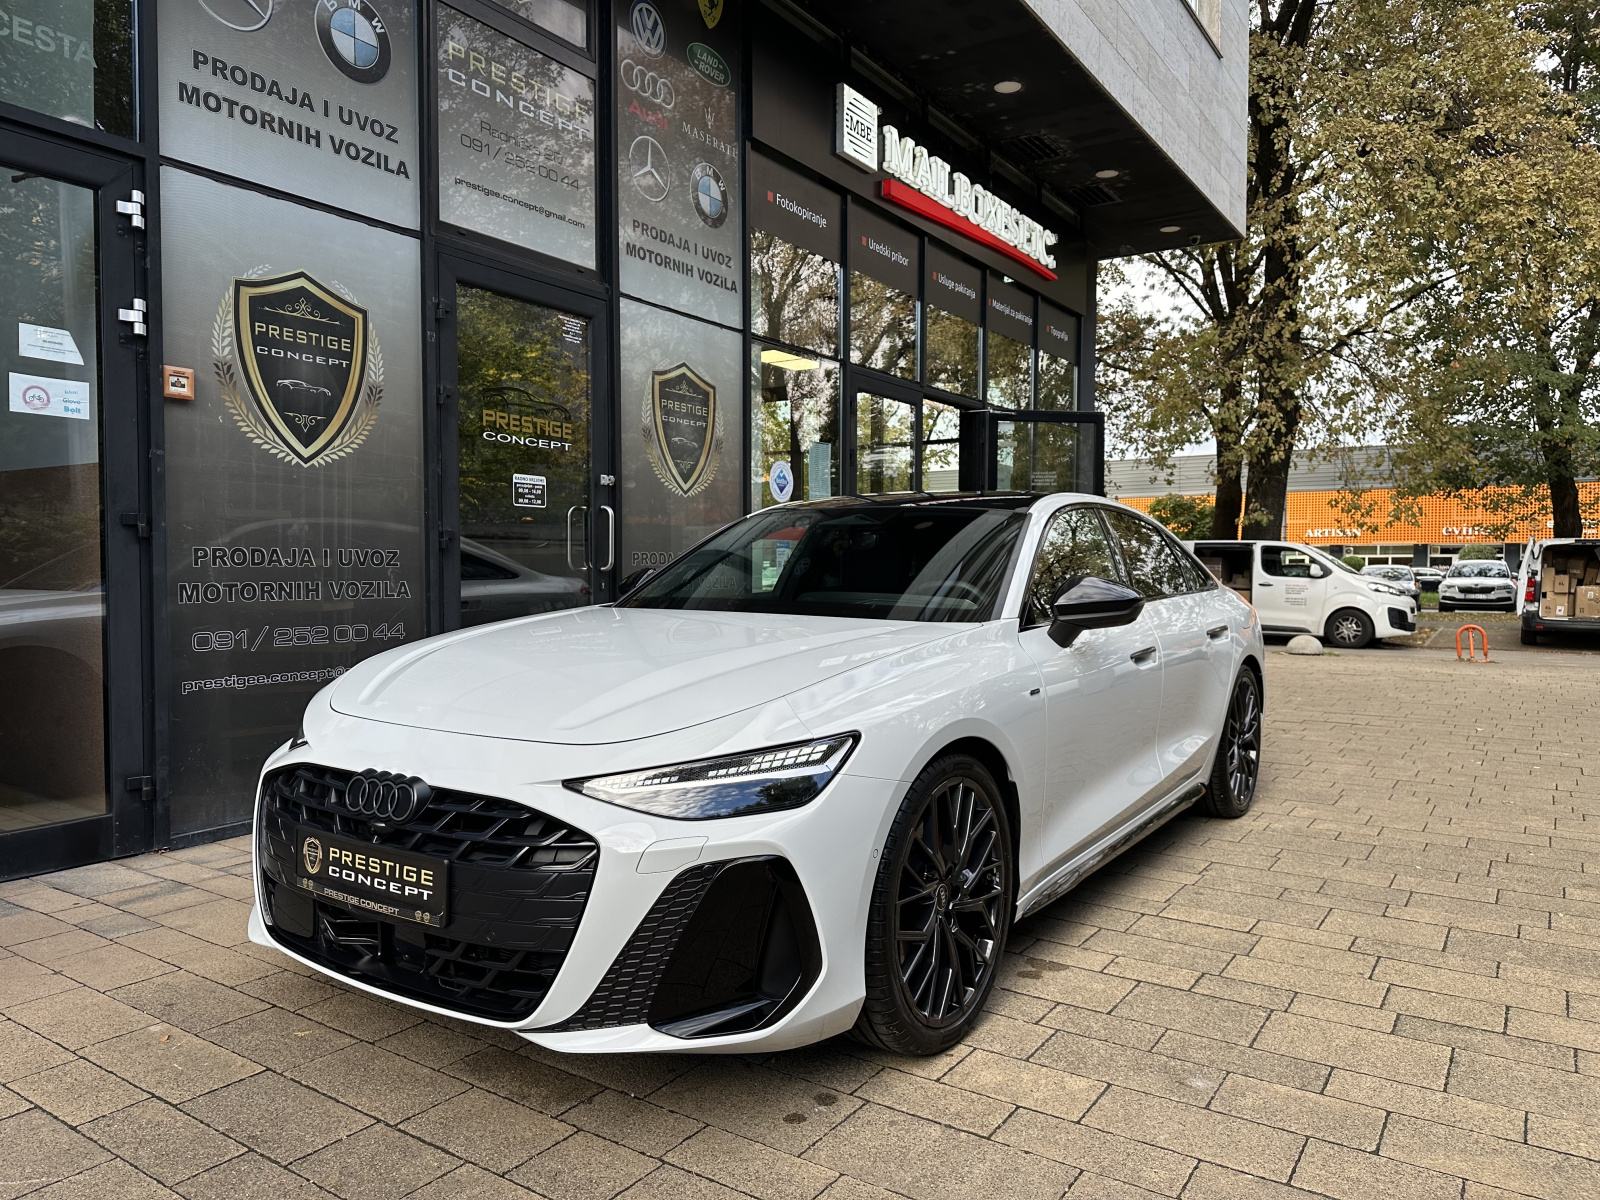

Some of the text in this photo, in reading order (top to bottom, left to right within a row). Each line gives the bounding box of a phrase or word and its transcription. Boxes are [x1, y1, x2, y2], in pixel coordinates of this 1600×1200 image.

[448, 41, 589, 121] PRESTIGE
[192, 49, 399, 144] PRODAJA I UVOZ
[448, 68, 590, 140] CONCEPT
[178, 82, 410, 179] MOTORNIH VOZILA
[849, 114, 873, 143] MBE
[504, 152, 536, 174] 252
[539, 165, 558, 182] 00
[561, 175, 579, 191] 44
[882, 125, 955, 208] MAIL
[952, 172, 1020, 246] BOXES
[454, 177, 586, 229] prestigee.concept@gmail.com
[776, 193, 827, 228] Fotokopiranje
[632, 219, 690, 253] PRODAJA
[702, 246, 732, 269] UVOZ
[868, 237, 909, 267] Uredski pribor
[626, 242, 738, 293] MOTORNIH VOZILA
[255, 322, 351, 352] PRESTIGE
[256, 345, 350, 368] CONCEPT
[661, 399, 708, 416] PRESTIGE
[662, 415, 707, 428] CONCEPT
[482, 409, 573, 439] PRESTIGE
[482, 431, 573, 451] CONCEPT
[1305, 527, 1361, 537] ARTISAN
[191, 546, 400, 568] PRODAJA I UVOZ
[631, 551, 676, 566] PRODA
[178, 580, 411, 604] MOTORNIH VOZILA
[273, 626, 329, 647] 252
[333, 624, 369, 642] 00
[373, 623, 406, 641] 44
[329, 847, 434, 887] PRESTIGE
[328, 865, 434, 901] CONCEPT
[323, 887, 400, 916] PRESTIGE CONCEPT
